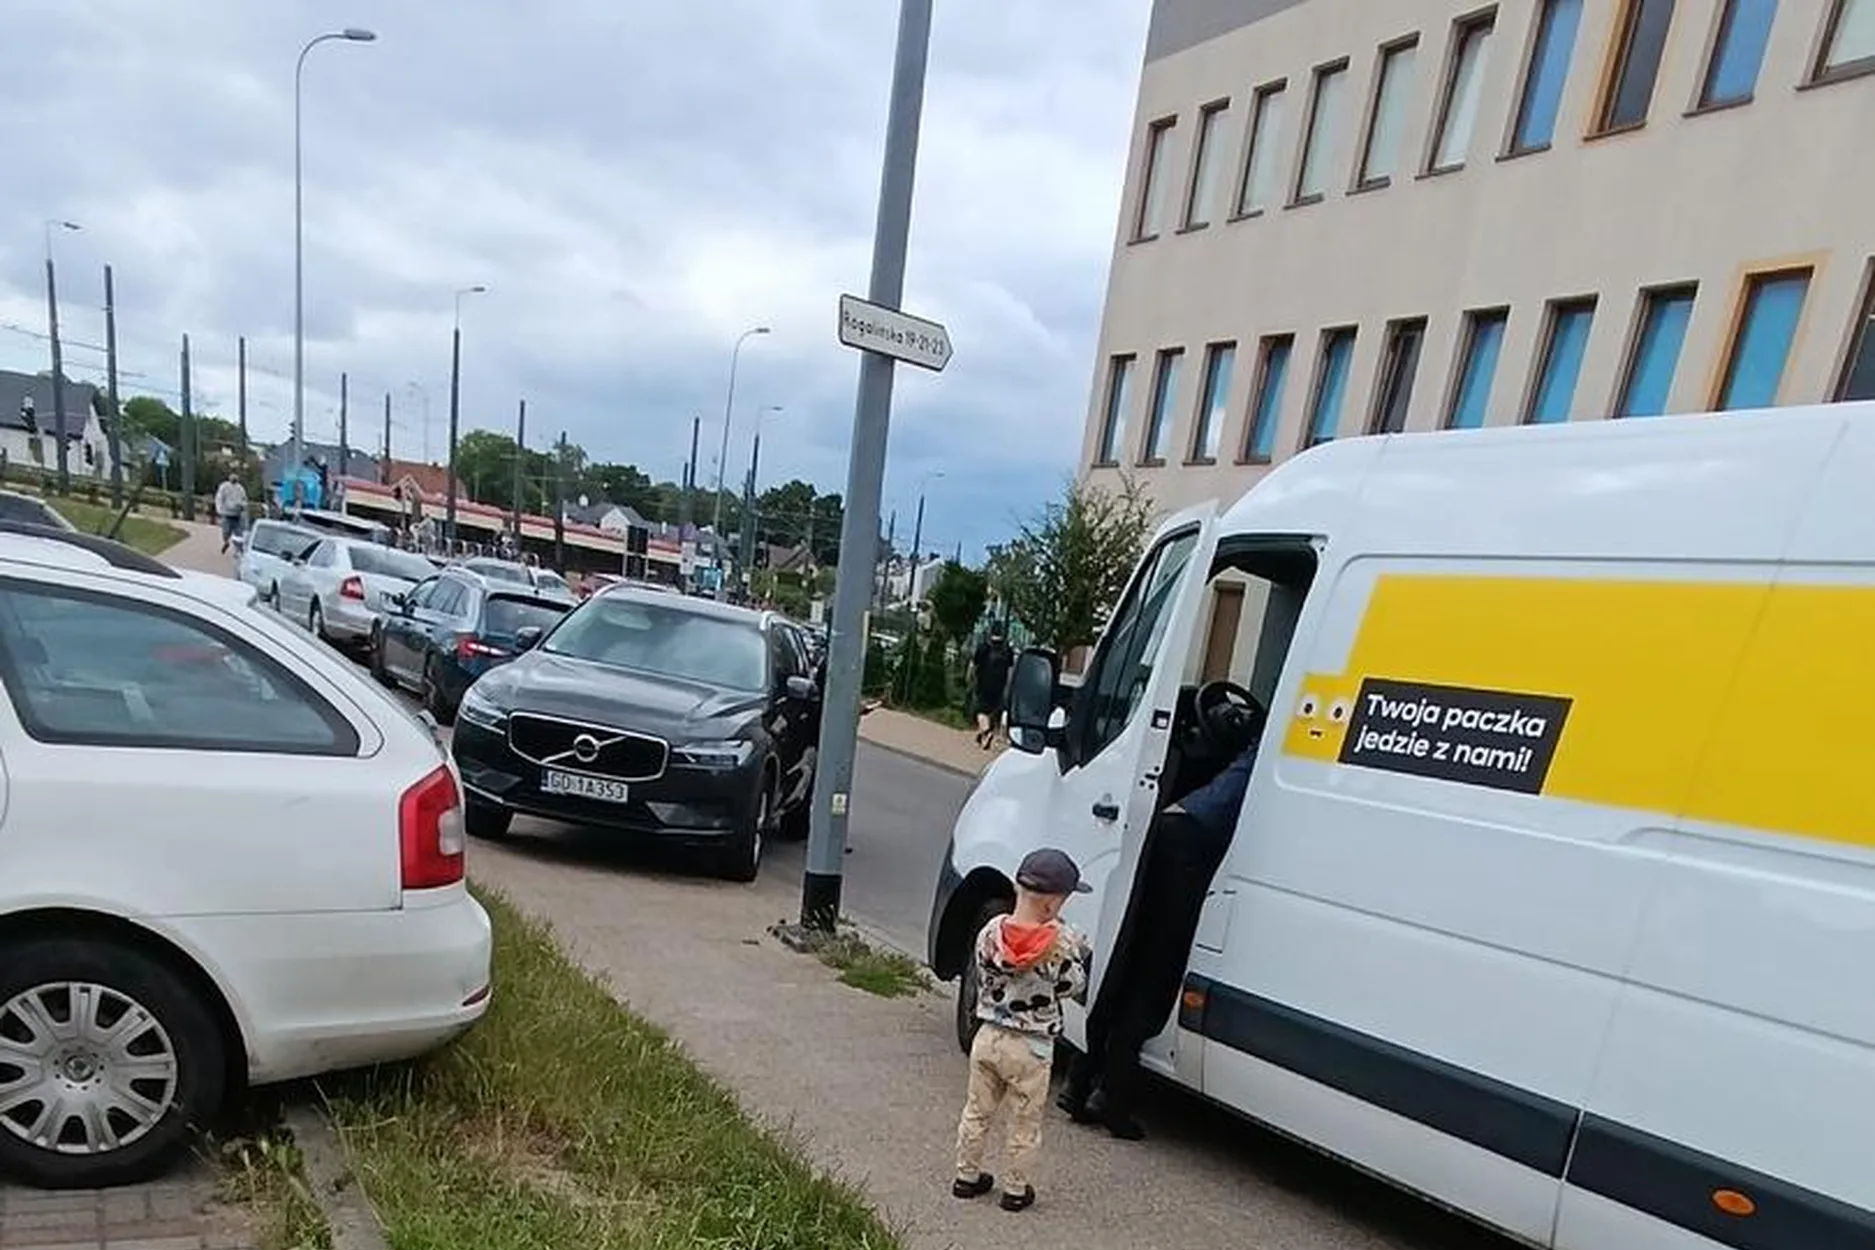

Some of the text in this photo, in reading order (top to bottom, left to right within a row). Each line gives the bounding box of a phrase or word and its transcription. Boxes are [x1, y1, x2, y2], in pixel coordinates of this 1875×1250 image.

[1367, 694, 1546, 738] Twoja paczka
[1354, 725, 1533, 772] jedzie z nami!
